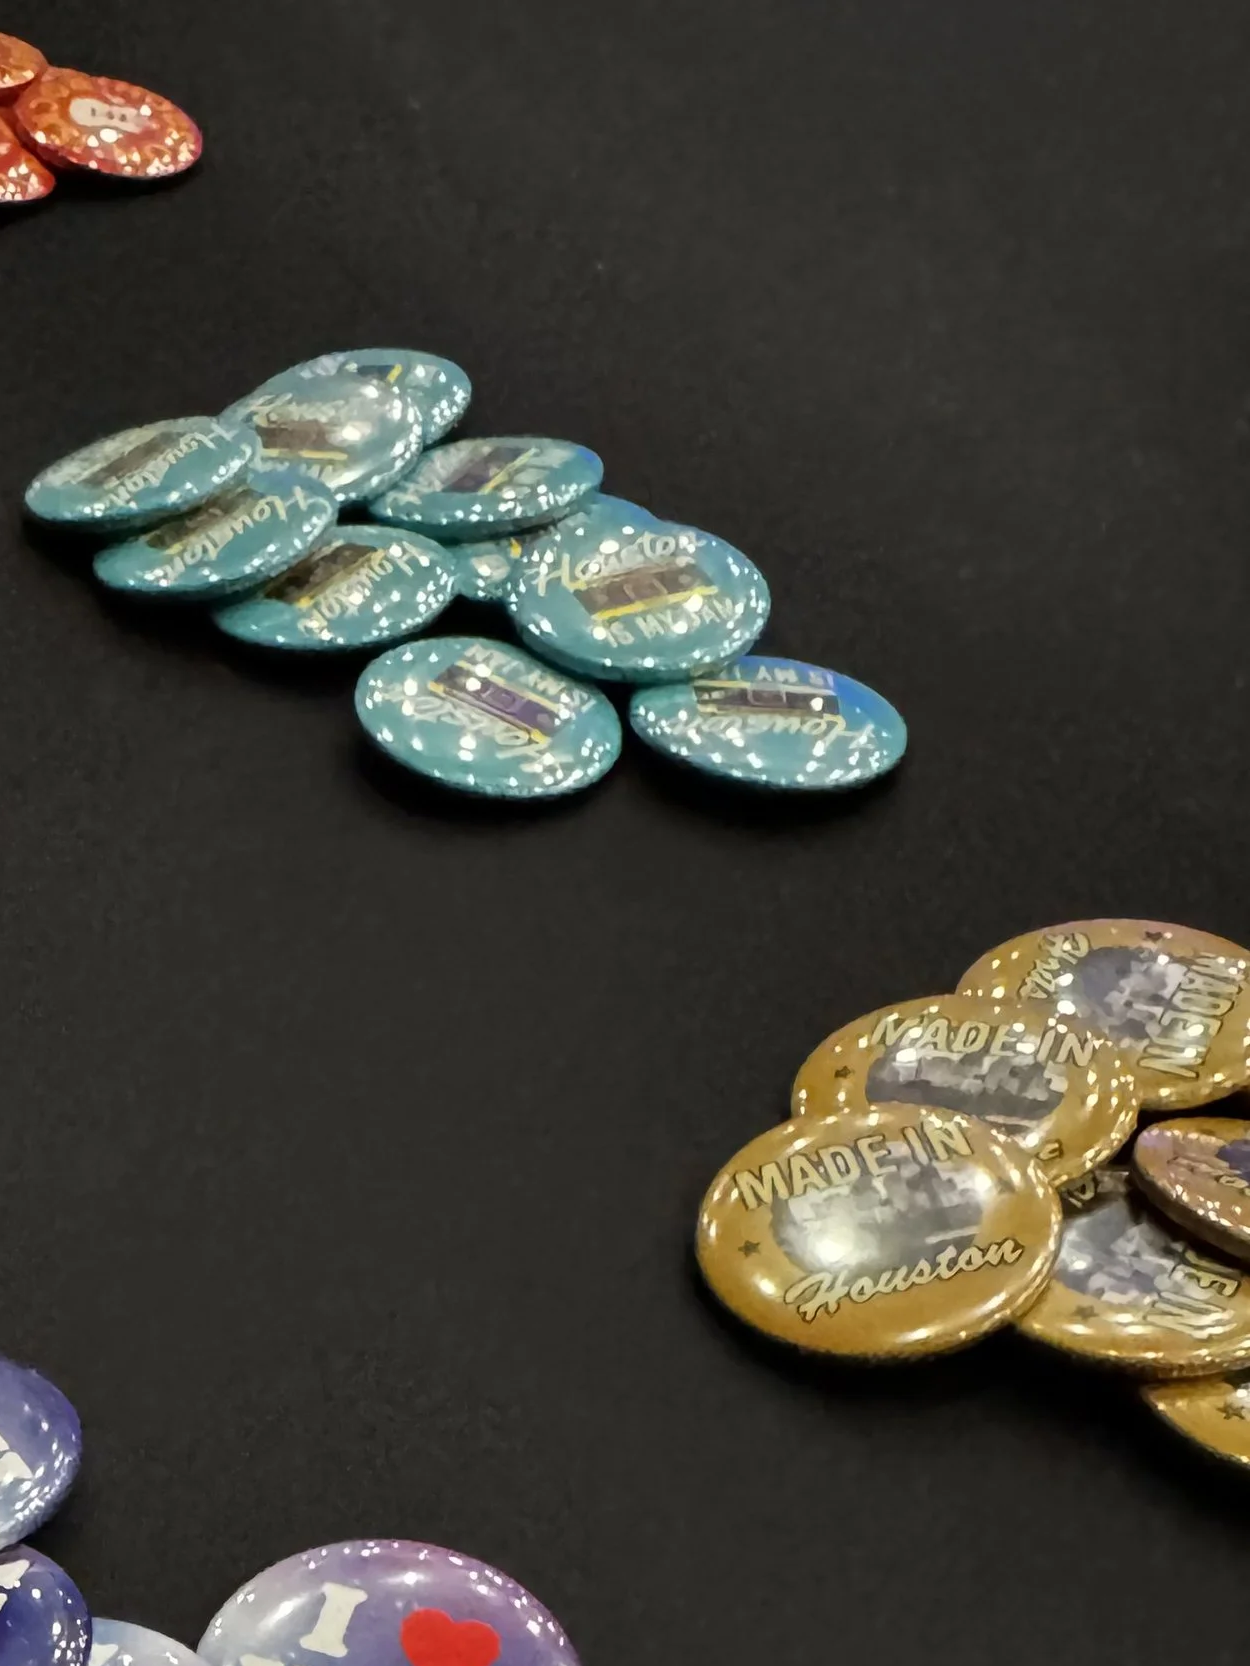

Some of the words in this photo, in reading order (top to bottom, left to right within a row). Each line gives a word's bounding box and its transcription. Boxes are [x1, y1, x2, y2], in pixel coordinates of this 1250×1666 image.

[869, 1012, 1018, 1058] MADE
[1034, 1029, 1094, 1067] IN
[733, 1132, 897, 1211] MADE
[901, 1118, 974, 1167] IN
[783, 1238, 1026, 1323] Houston
[300, 1582, 368, 1658] I
